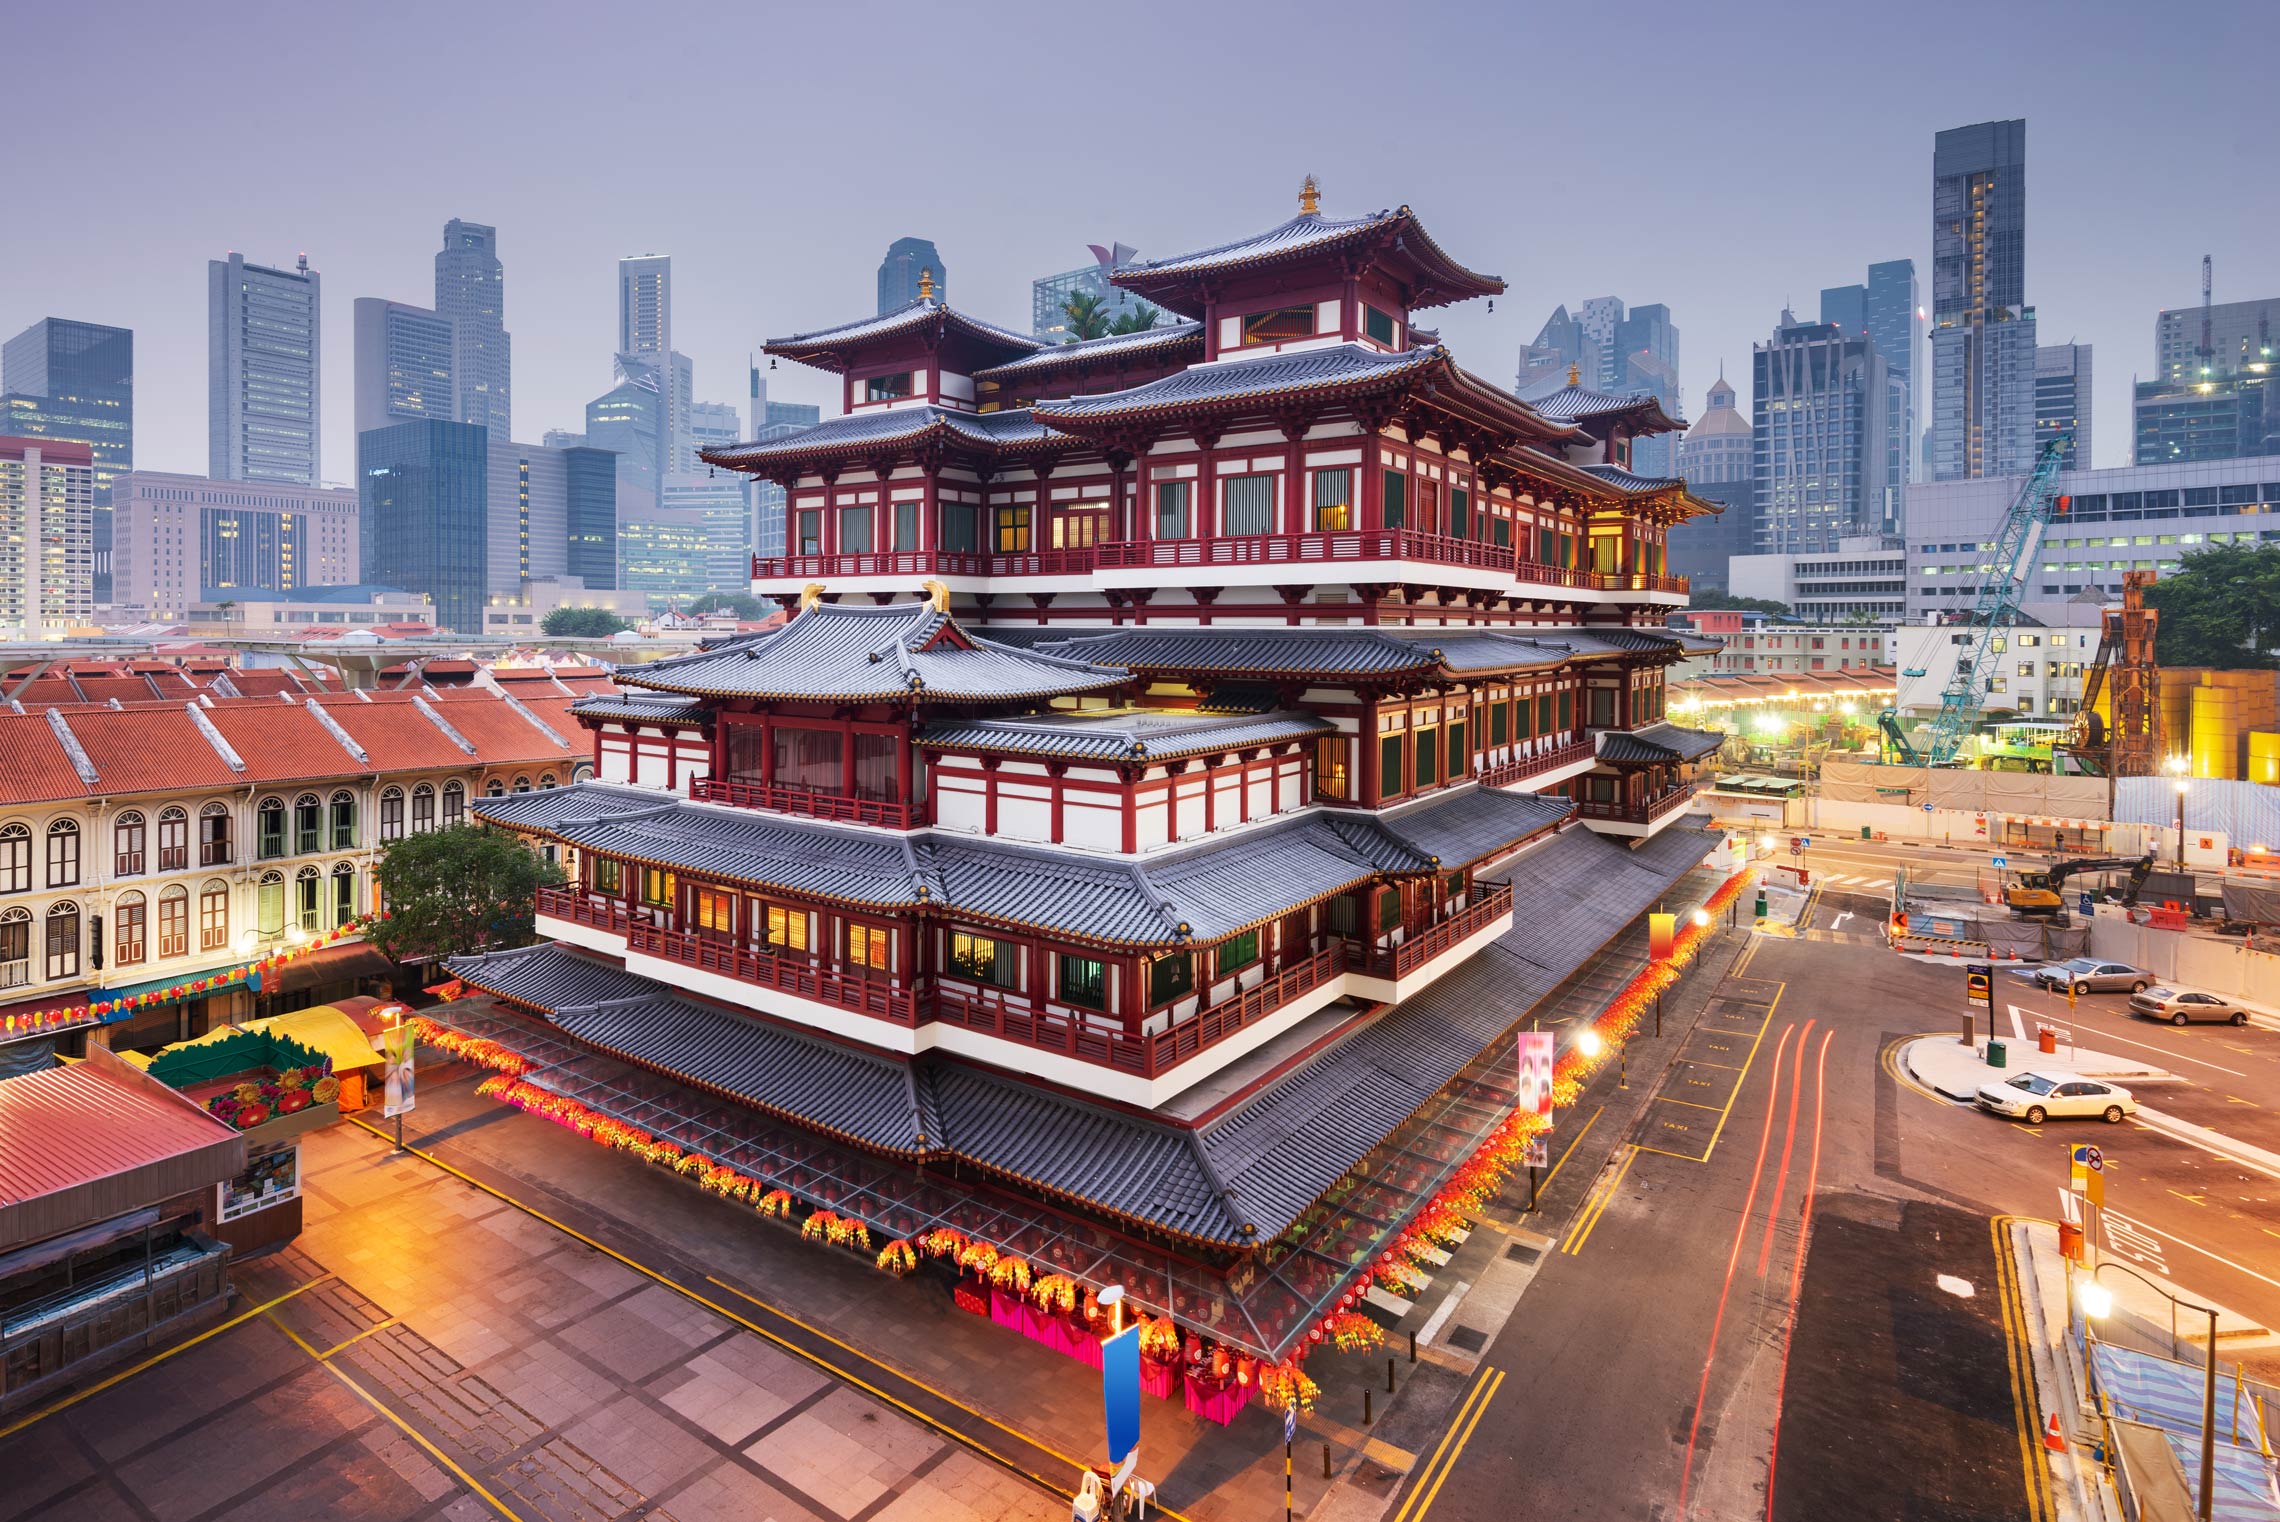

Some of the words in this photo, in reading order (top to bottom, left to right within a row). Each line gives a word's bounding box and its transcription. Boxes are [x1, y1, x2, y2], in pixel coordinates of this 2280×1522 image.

[1688, 1079, 1711, 1087] TAXI
[1663, 1121, 1689, 1131] TAXI
[2100, 1212, 2170, 1275] STOP
